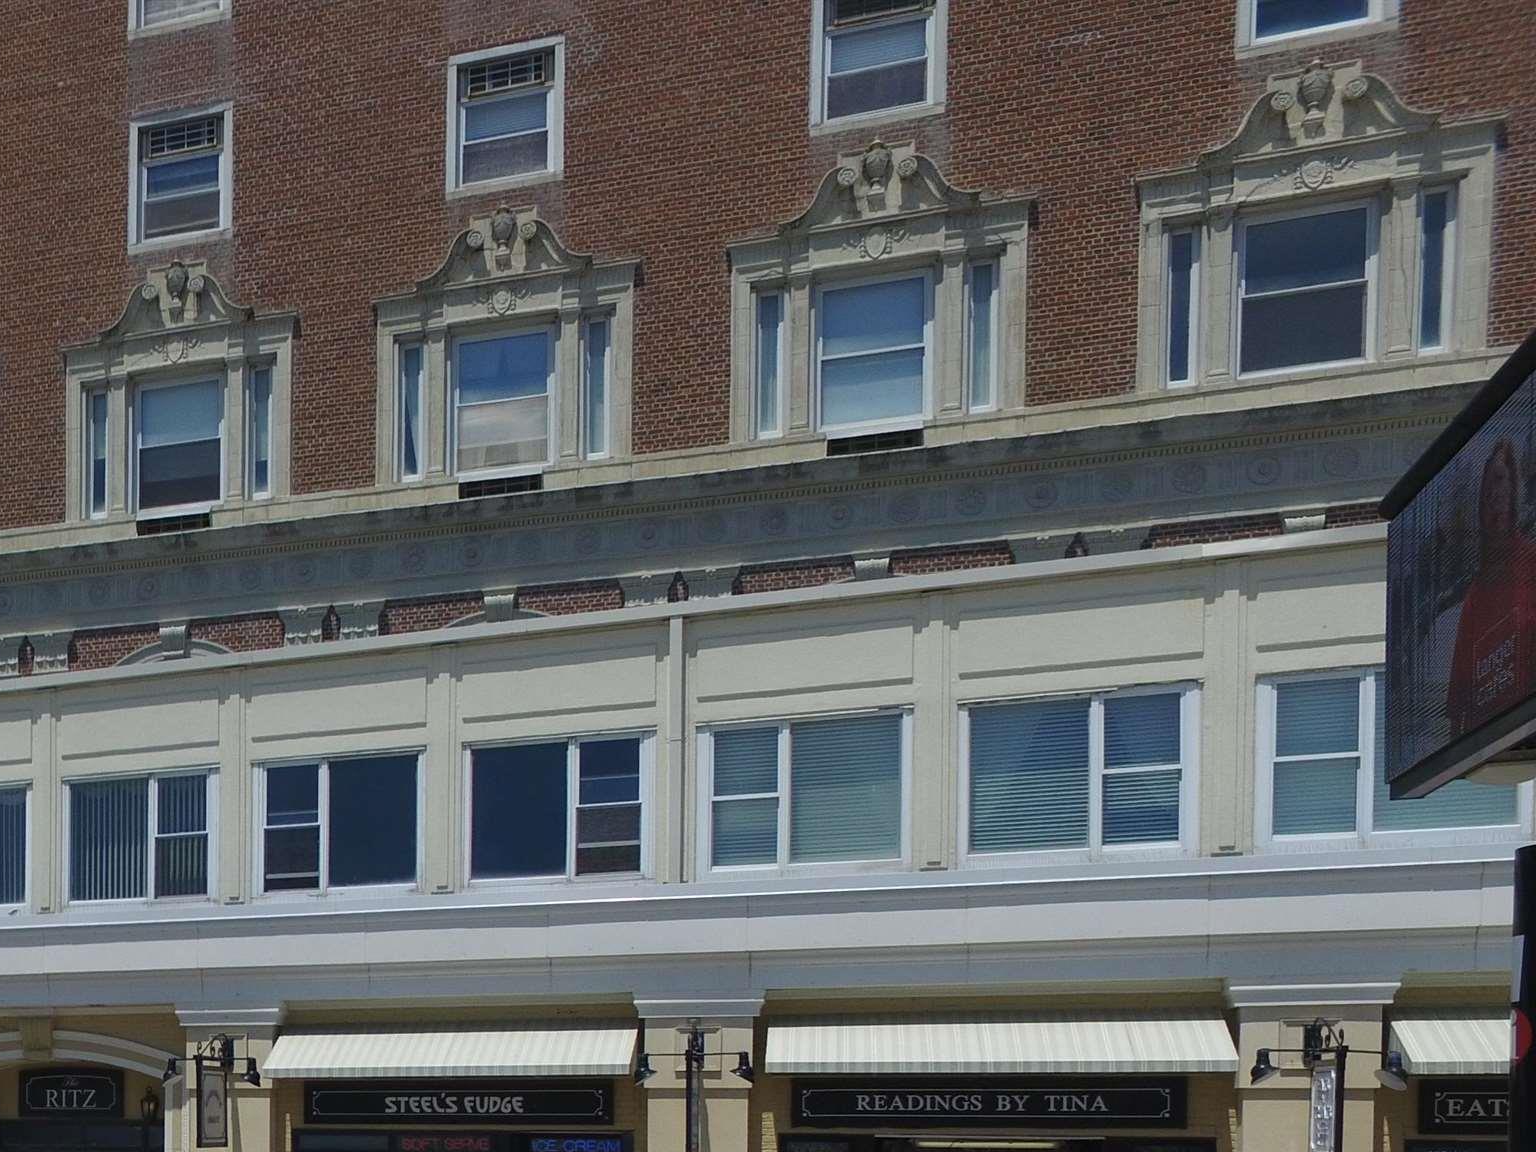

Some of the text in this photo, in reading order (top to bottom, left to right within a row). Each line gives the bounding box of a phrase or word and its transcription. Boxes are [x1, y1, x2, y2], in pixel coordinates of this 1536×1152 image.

[46, 1089, 96, 1108] RITZ
[385, 1093, 524, 1113] STEEL'S FUDGE
[856, 1095, 1109, 1112] READINGS BY TINA
[402, 1138, 489, 1151] SOFT SERVE
[531, 1139, 621, 1152] ICE CREAM
